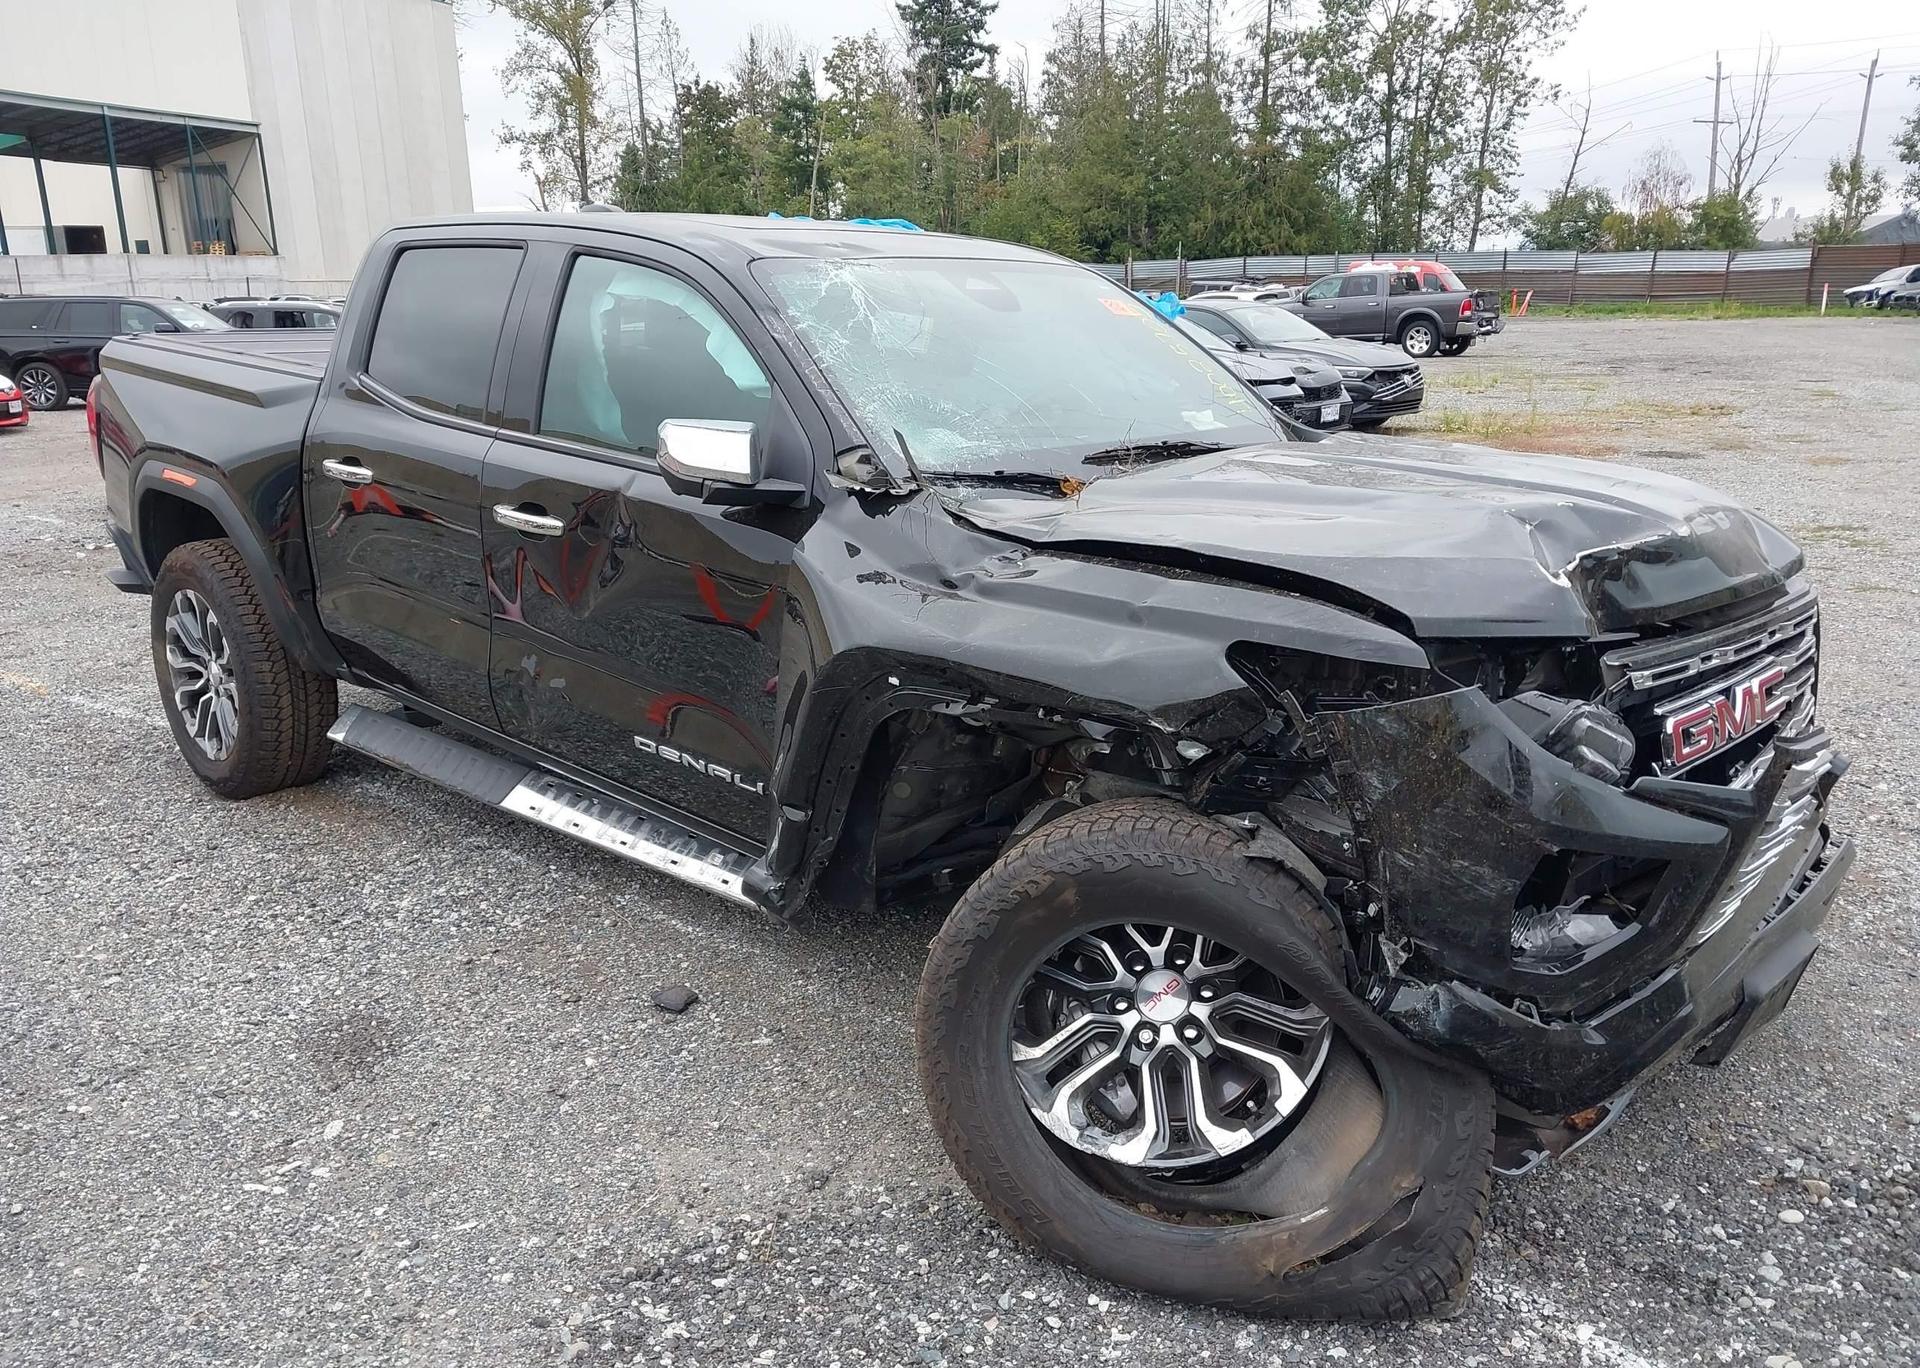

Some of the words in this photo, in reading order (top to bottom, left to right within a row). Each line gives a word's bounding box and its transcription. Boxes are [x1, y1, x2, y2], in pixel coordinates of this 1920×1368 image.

[1668, 666, 1789, 766] GMC
[633, 736, 764, 795] DENALI
[1144, 978, 1181, 1012] GMC
